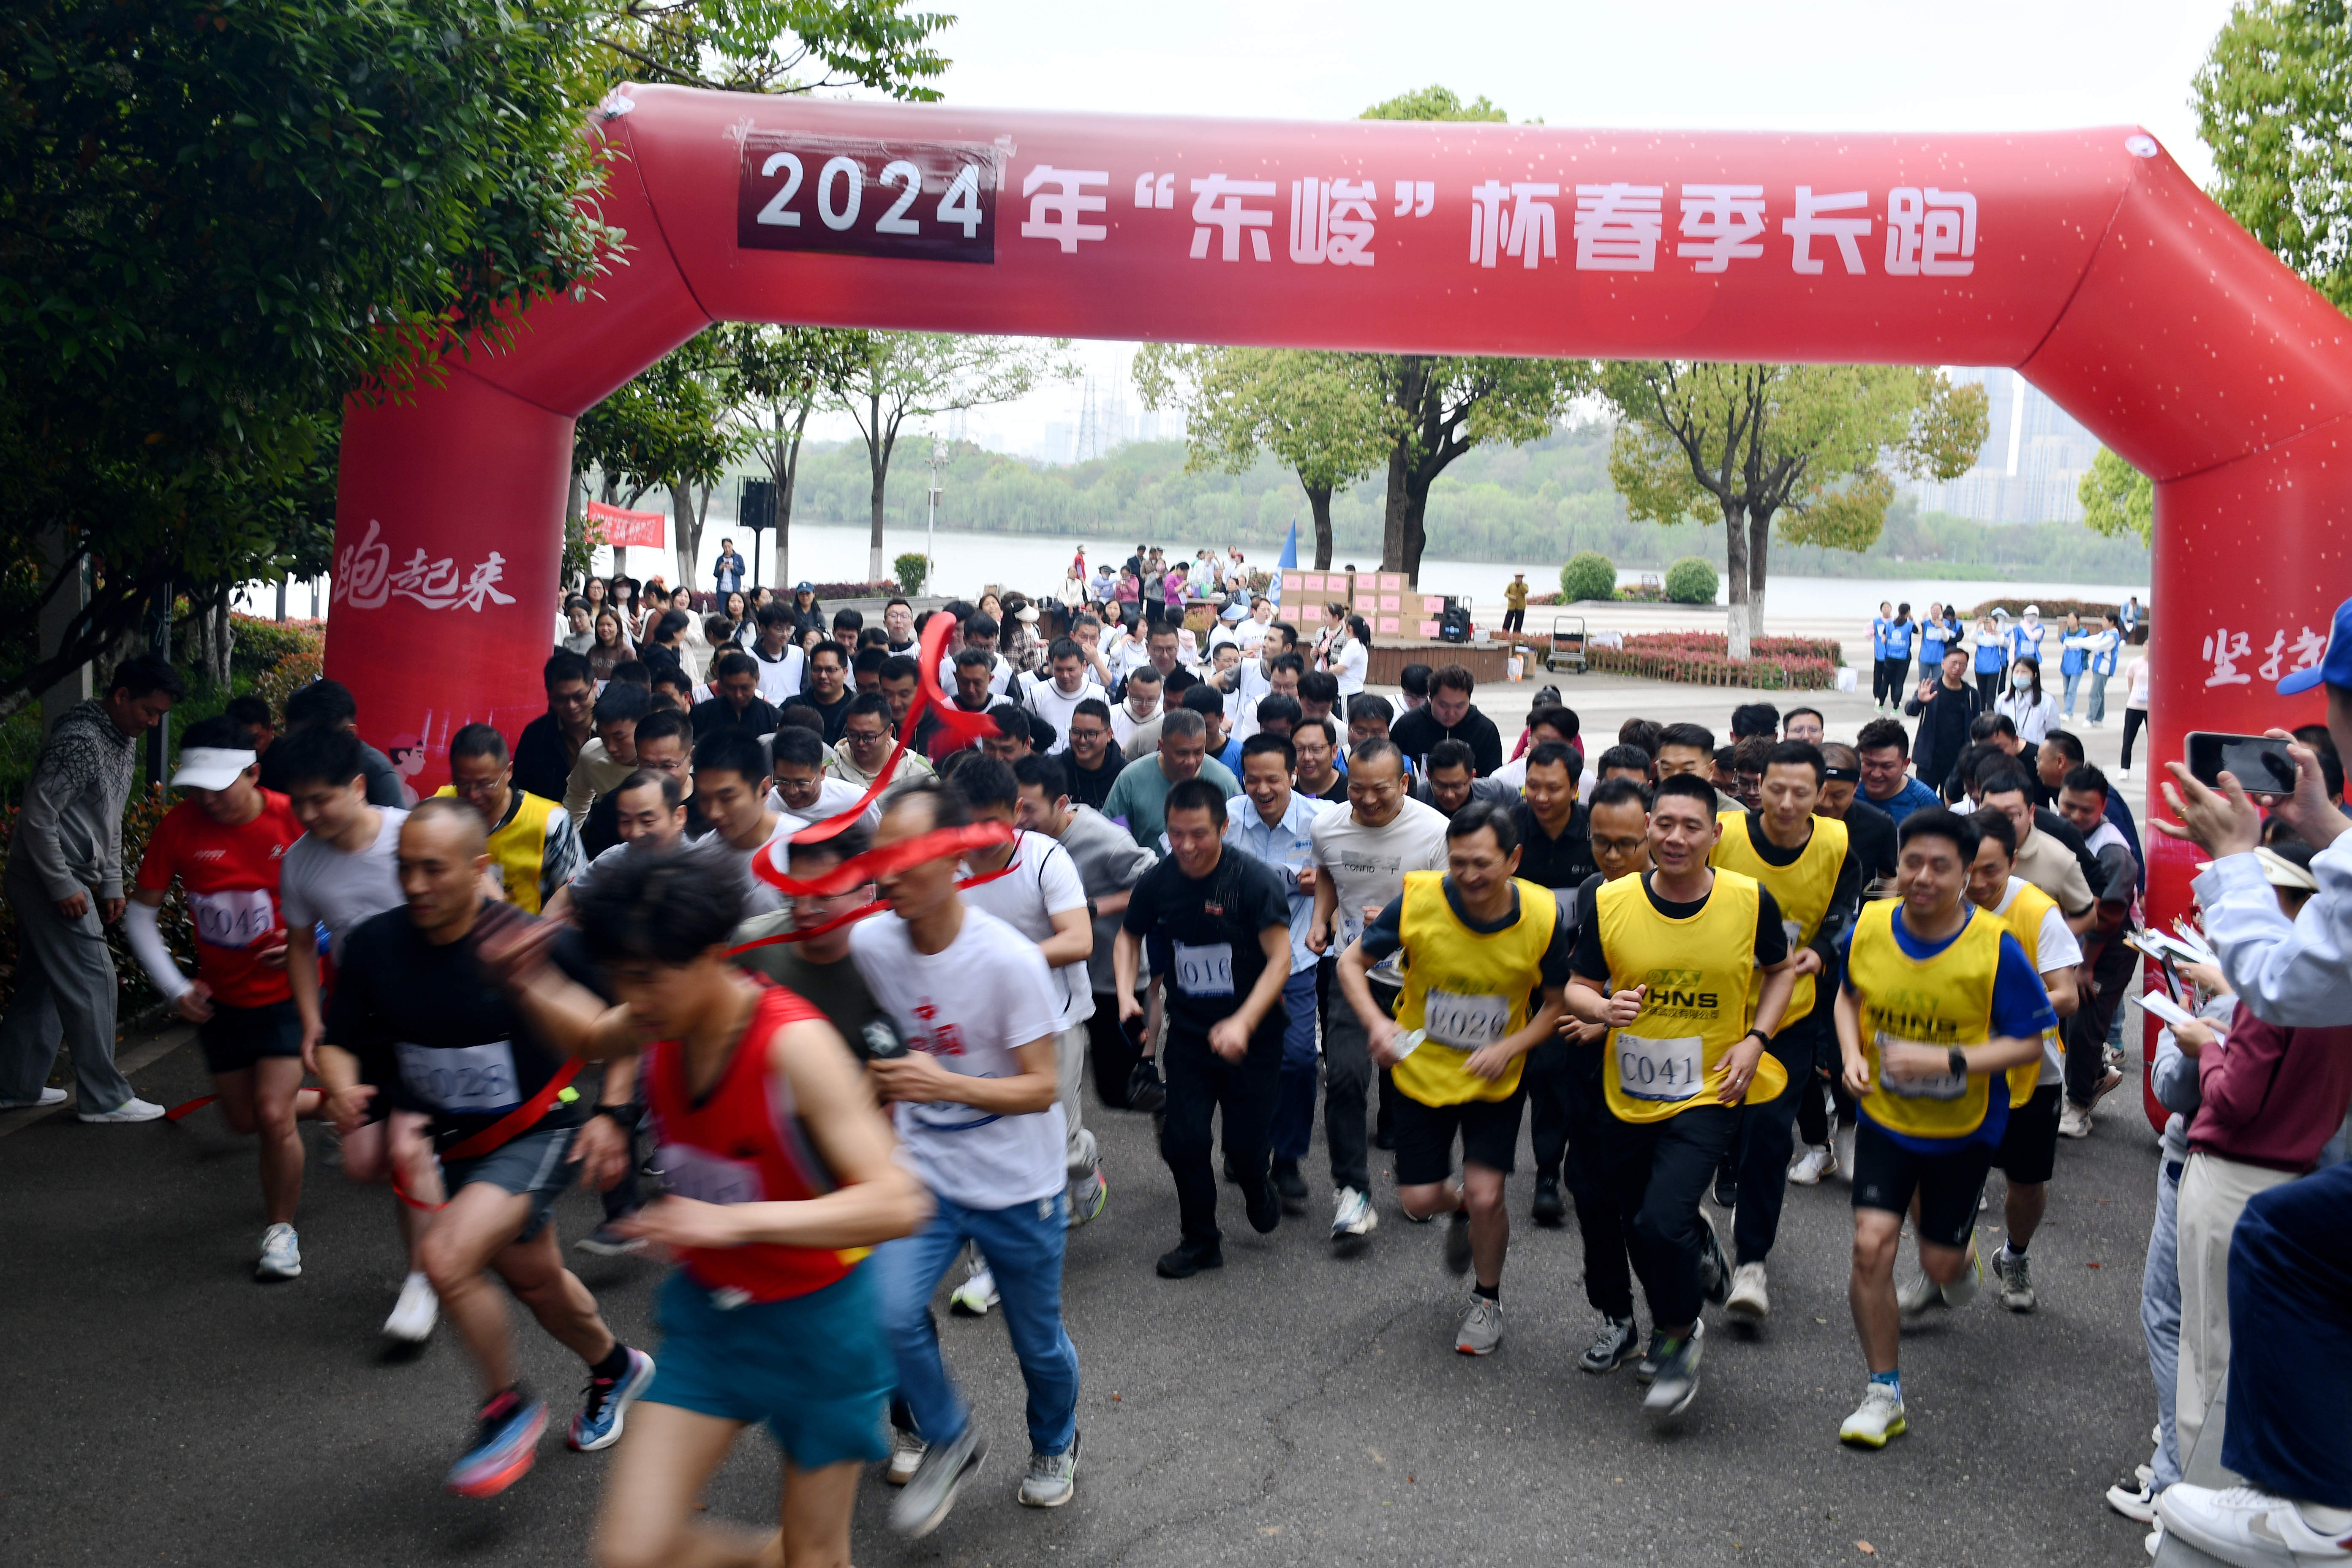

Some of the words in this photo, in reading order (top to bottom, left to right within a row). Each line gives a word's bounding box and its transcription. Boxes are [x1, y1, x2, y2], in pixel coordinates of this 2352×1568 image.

[334, 519, 516, 612] 跑起来
[1642, 987, 1718, 1007] HNS
[1622, 1052, 1695, 1086] C041
